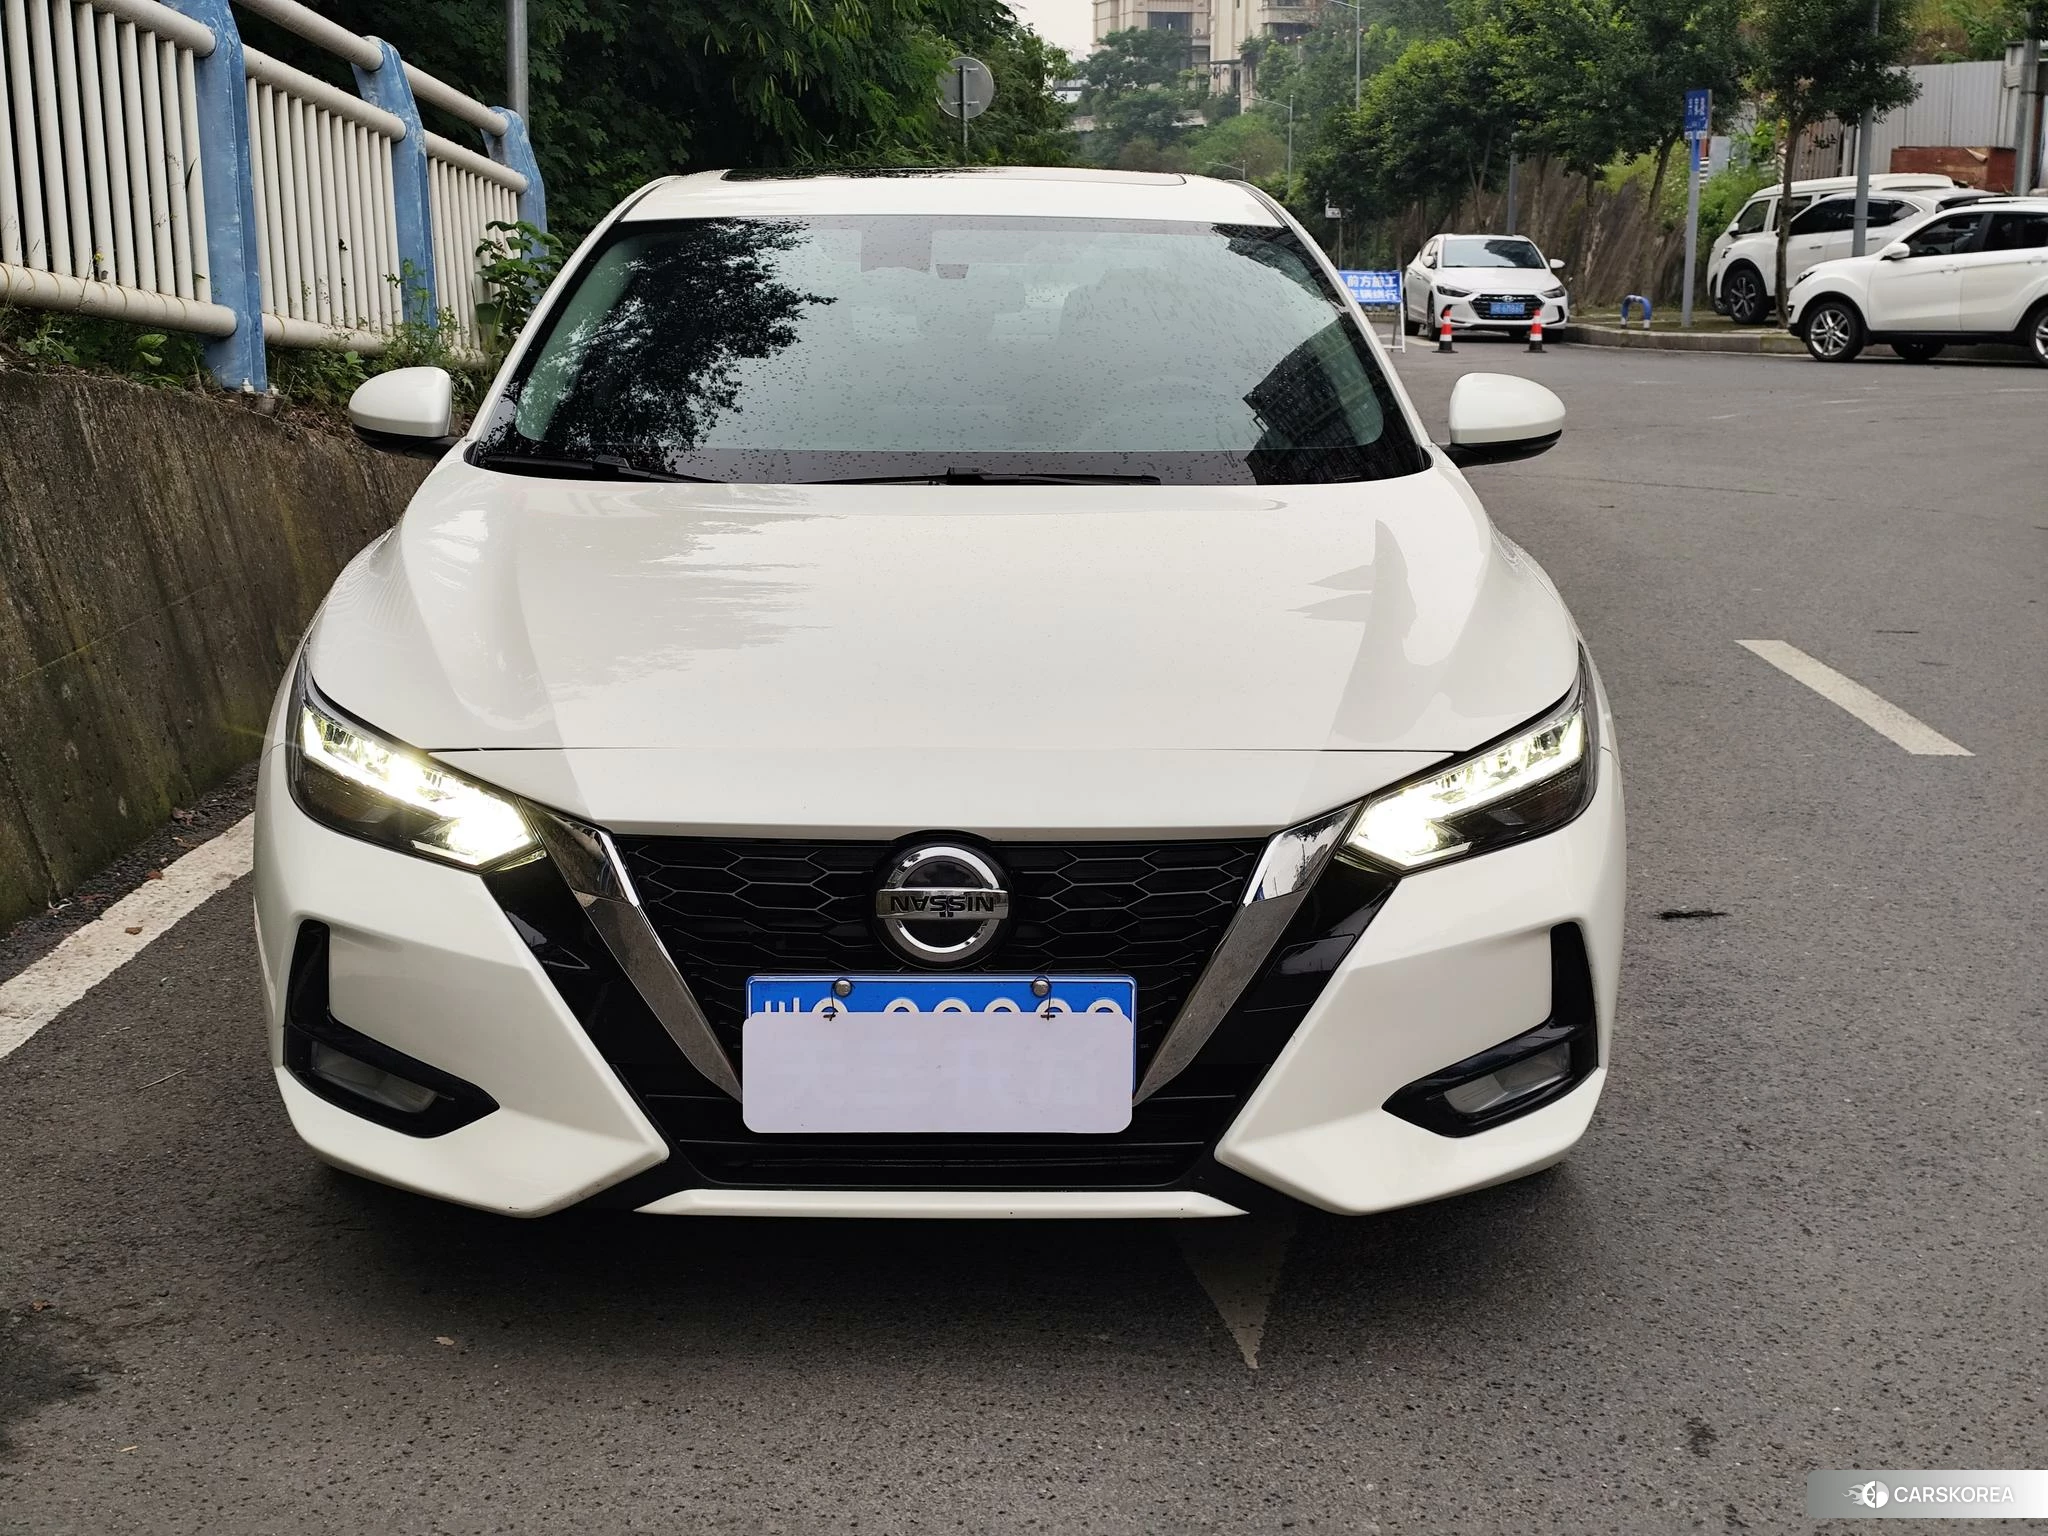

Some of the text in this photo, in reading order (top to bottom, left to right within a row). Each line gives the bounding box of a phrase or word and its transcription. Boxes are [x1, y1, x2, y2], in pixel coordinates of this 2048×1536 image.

[1347, 275, 1397, 288] 前方施工
[890, 895, 994, 912] NISSAN
